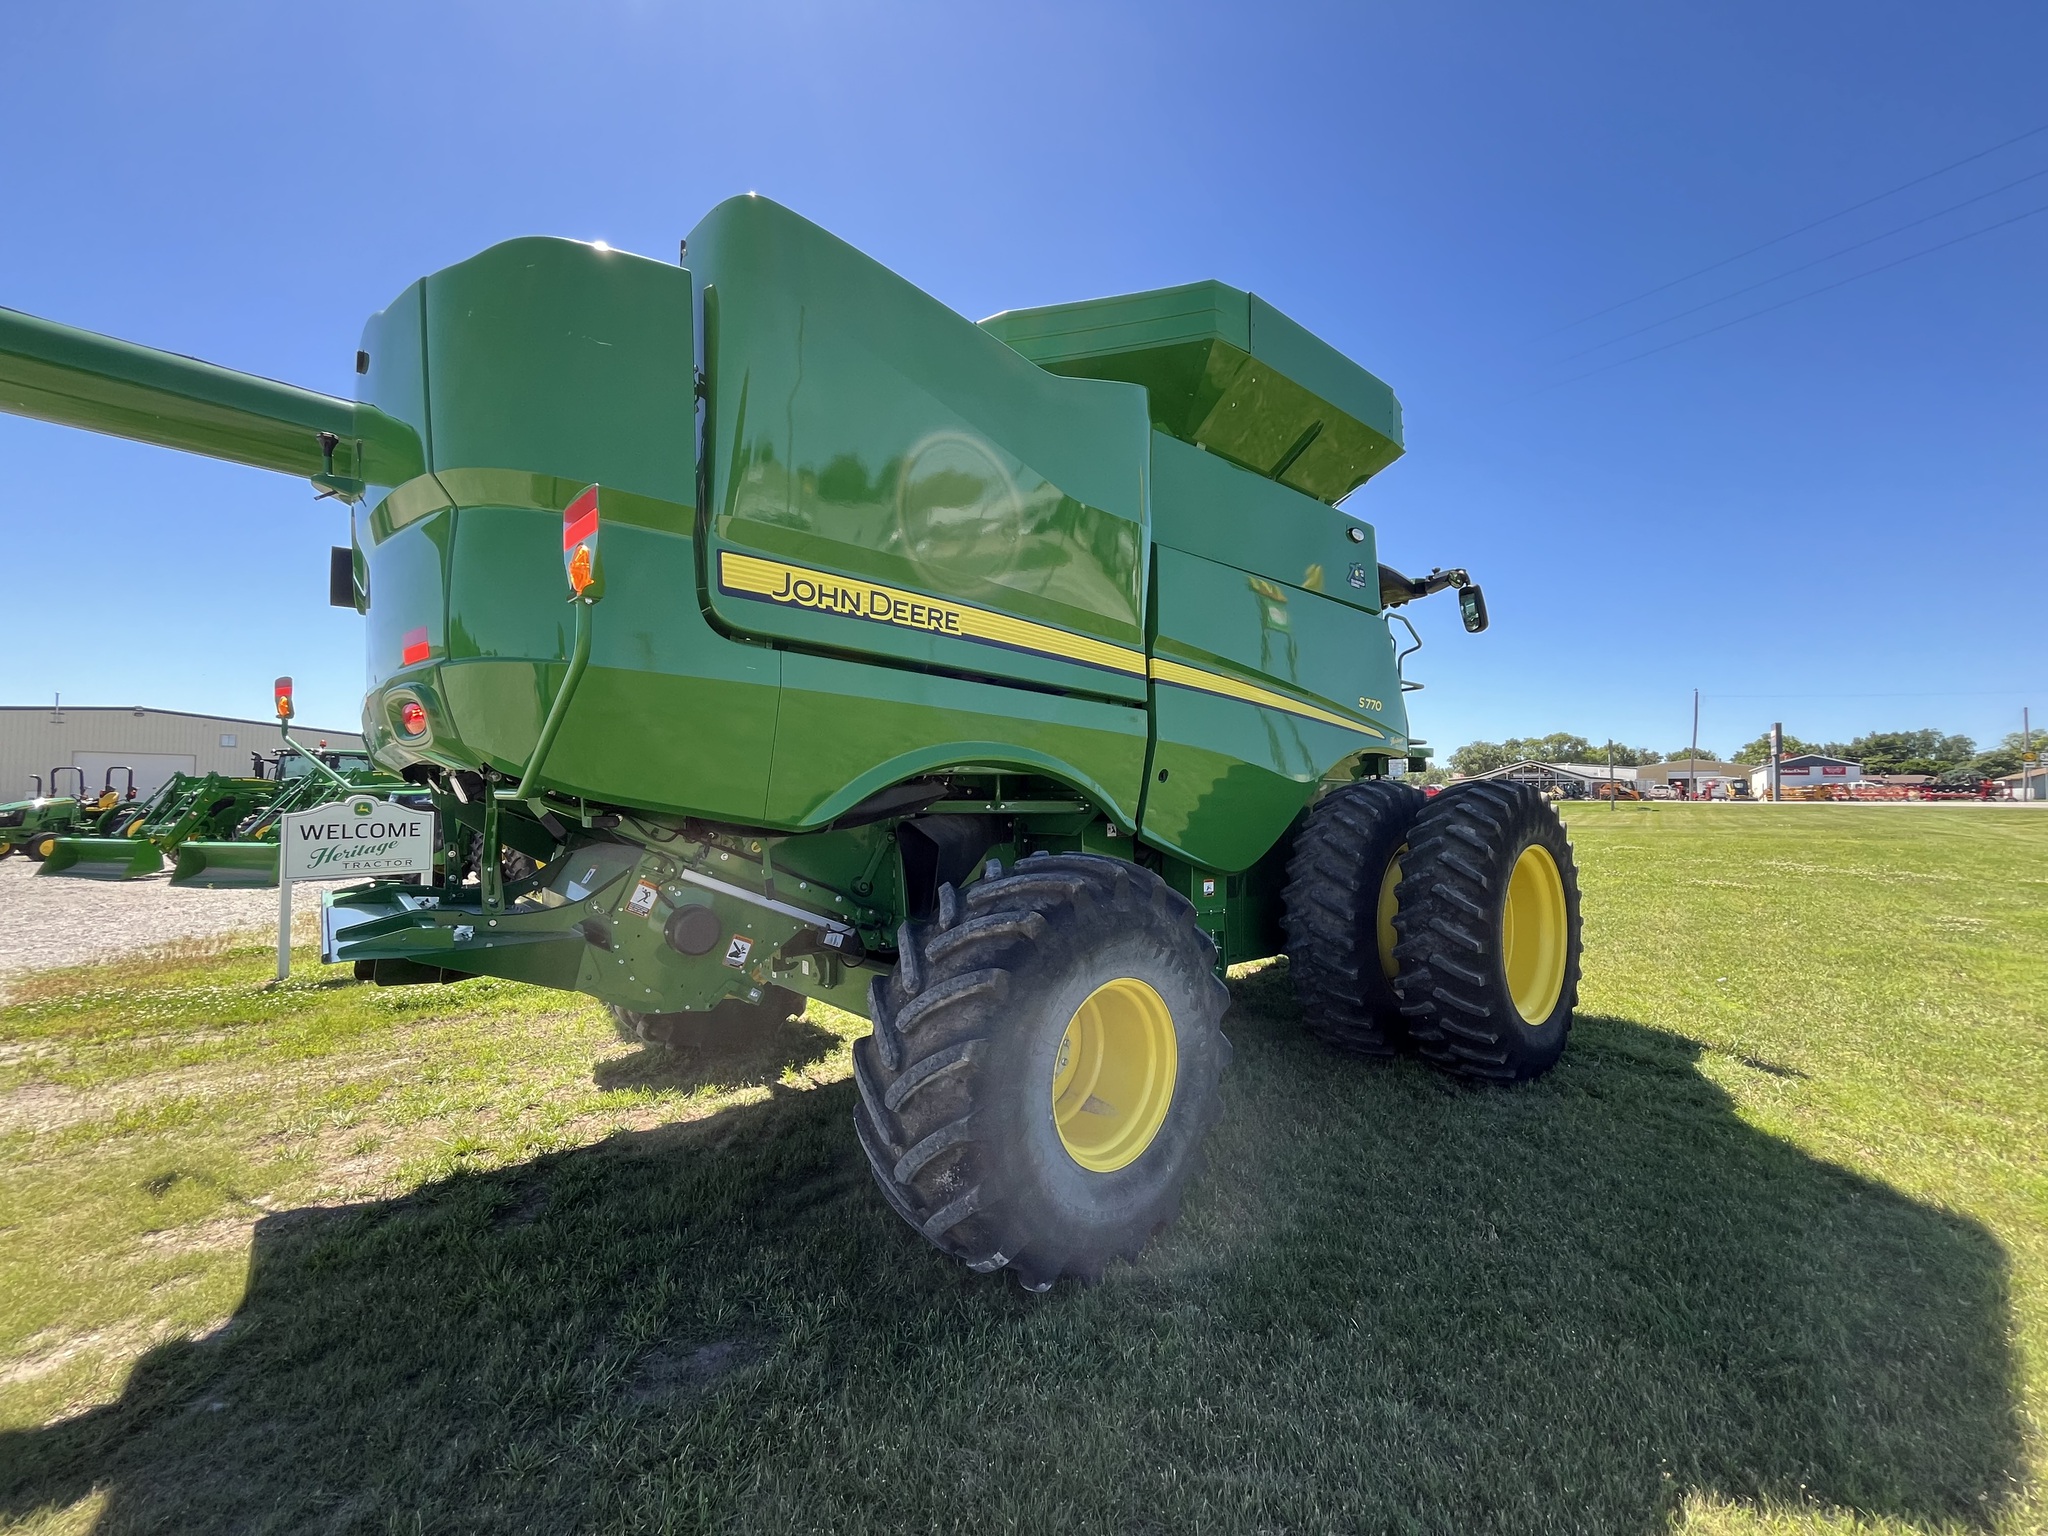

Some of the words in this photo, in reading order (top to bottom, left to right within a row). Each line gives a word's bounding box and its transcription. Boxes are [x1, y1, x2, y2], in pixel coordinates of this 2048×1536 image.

[772, 572, 862, 614] JOHN
[869, 590, 961, 633] DEERE
[1358, 696, 1383, 712] S770
[300, 822, 421, 840] WELCOME
[307, 840, 399, 870] Heritage
[342, 859, 413, 869] TRACTOR
